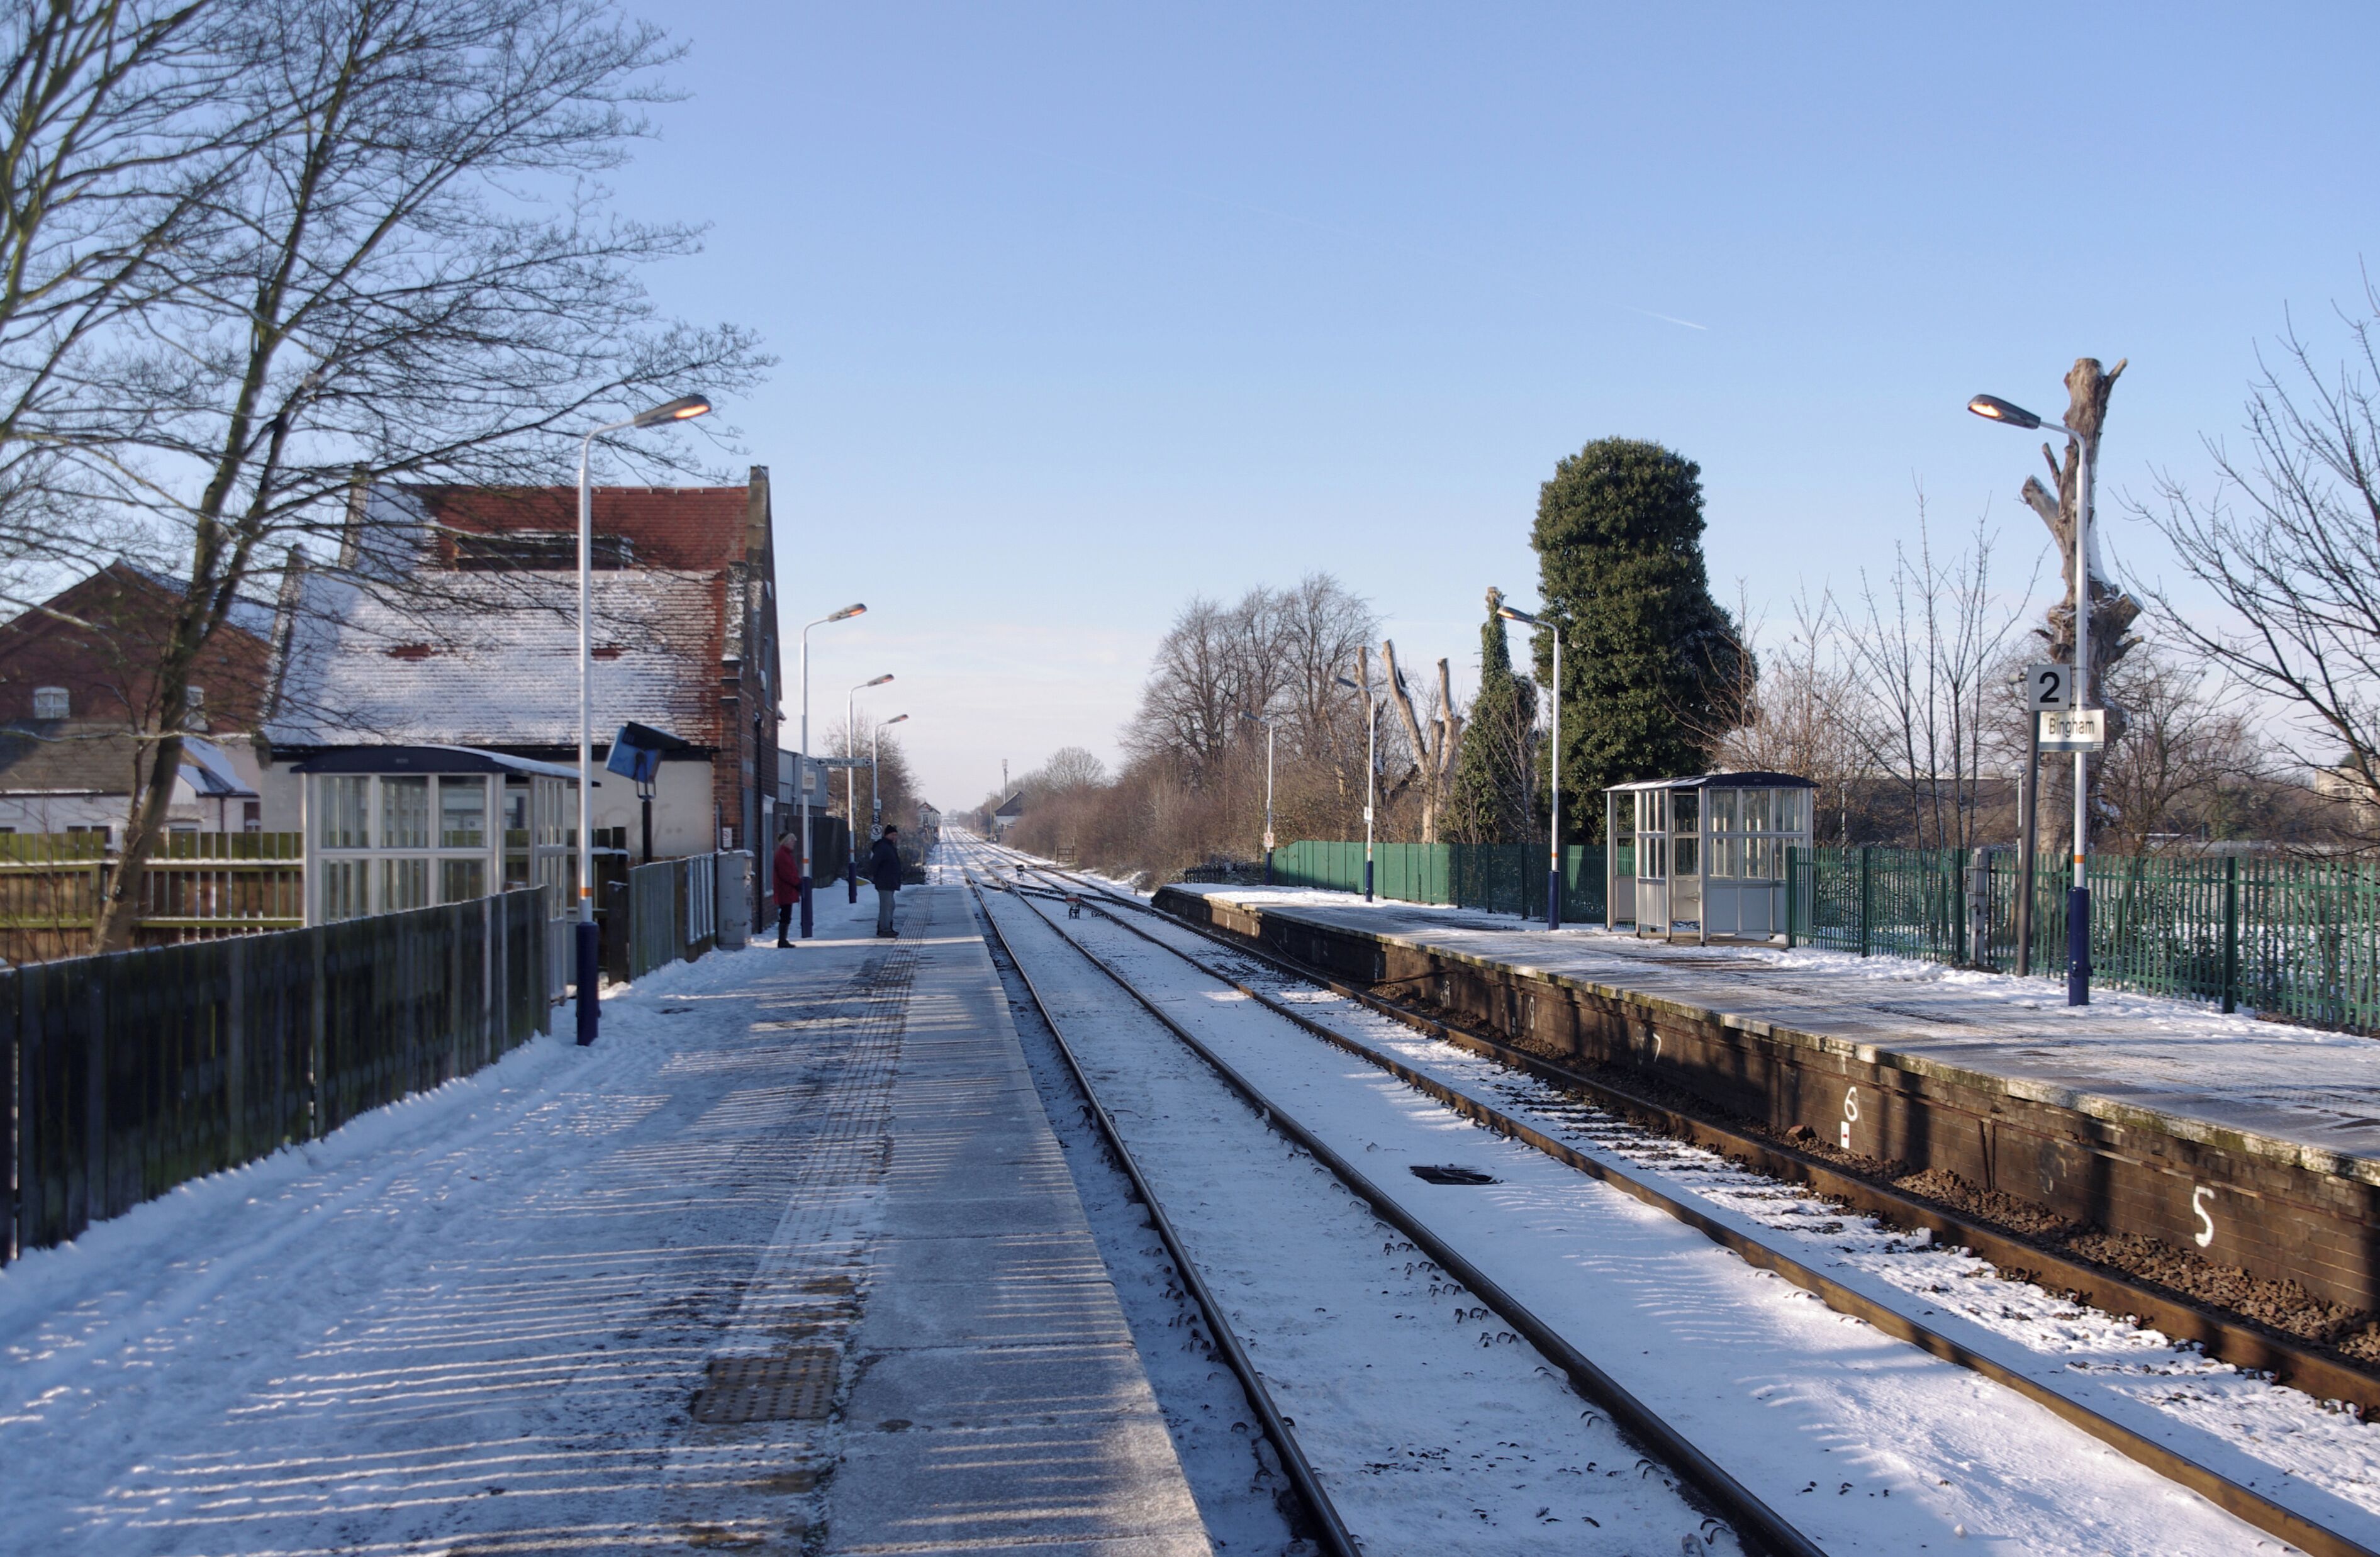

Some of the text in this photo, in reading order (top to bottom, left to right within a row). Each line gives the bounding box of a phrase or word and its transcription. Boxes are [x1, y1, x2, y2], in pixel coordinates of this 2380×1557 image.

[2039, 671, 2060, 703] 2
[2048, 717, 2094, 737] Bingham
[1529, 996, 1535, 1030] 8
[1652, 1032, 1662, 1063] 7
[1844, 1086, 1858, 1129] 6
[2193, 1185, 2215, 1248] 5
